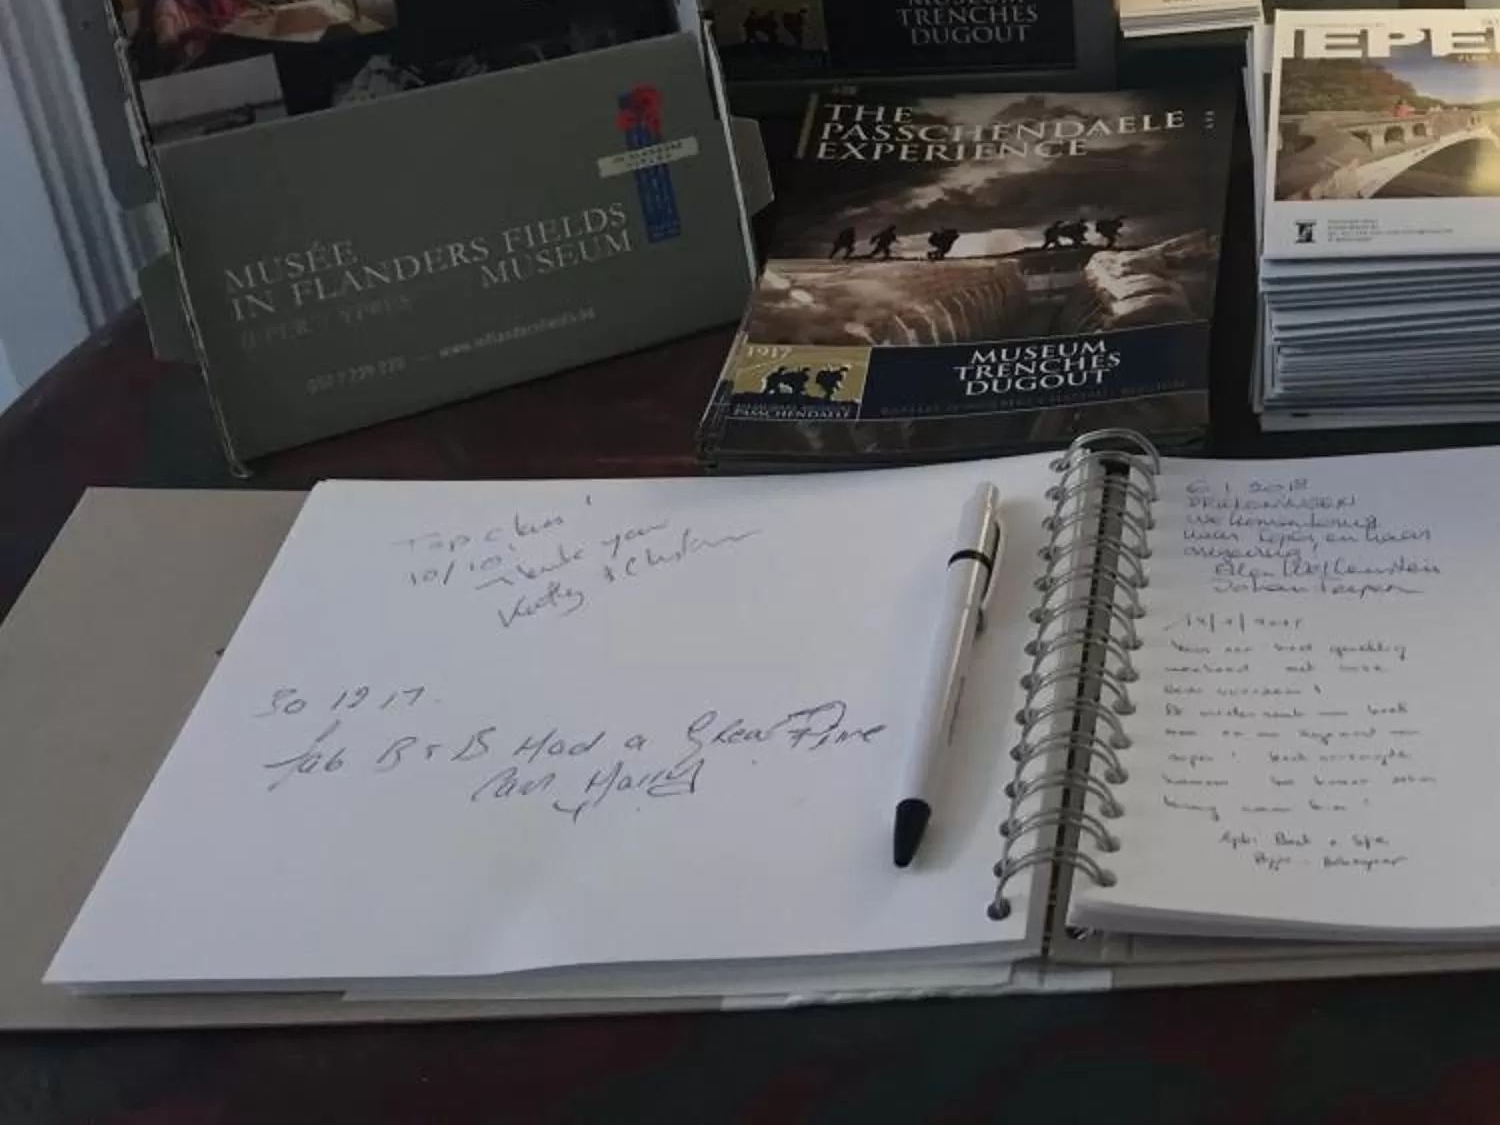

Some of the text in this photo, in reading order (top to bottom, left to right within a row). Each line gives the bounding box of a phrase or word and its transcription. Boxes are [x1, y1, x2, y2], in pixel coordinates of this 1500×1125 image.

[896, 2, 1039, 27] TRENCHES
[910, 24, 1033, 45] DUGOUT
[821, 108, 1186, 143] PASSCHENDAELE
[823, 103, 913, 124] THE
[816, 138, 1089, 162] EXPERIENCE
[223, 238, 358, 294] MUSÉE
[230, 202, 630, 322] IN FLANDERS FIELDS
[480, 229, 632, 289] MUSEUM
[953, 350, 1122, 382] TRENCHES
[970, 338, 1108, 365] MUSEUM
[964, 369, 1112, 398] DUGOUT
